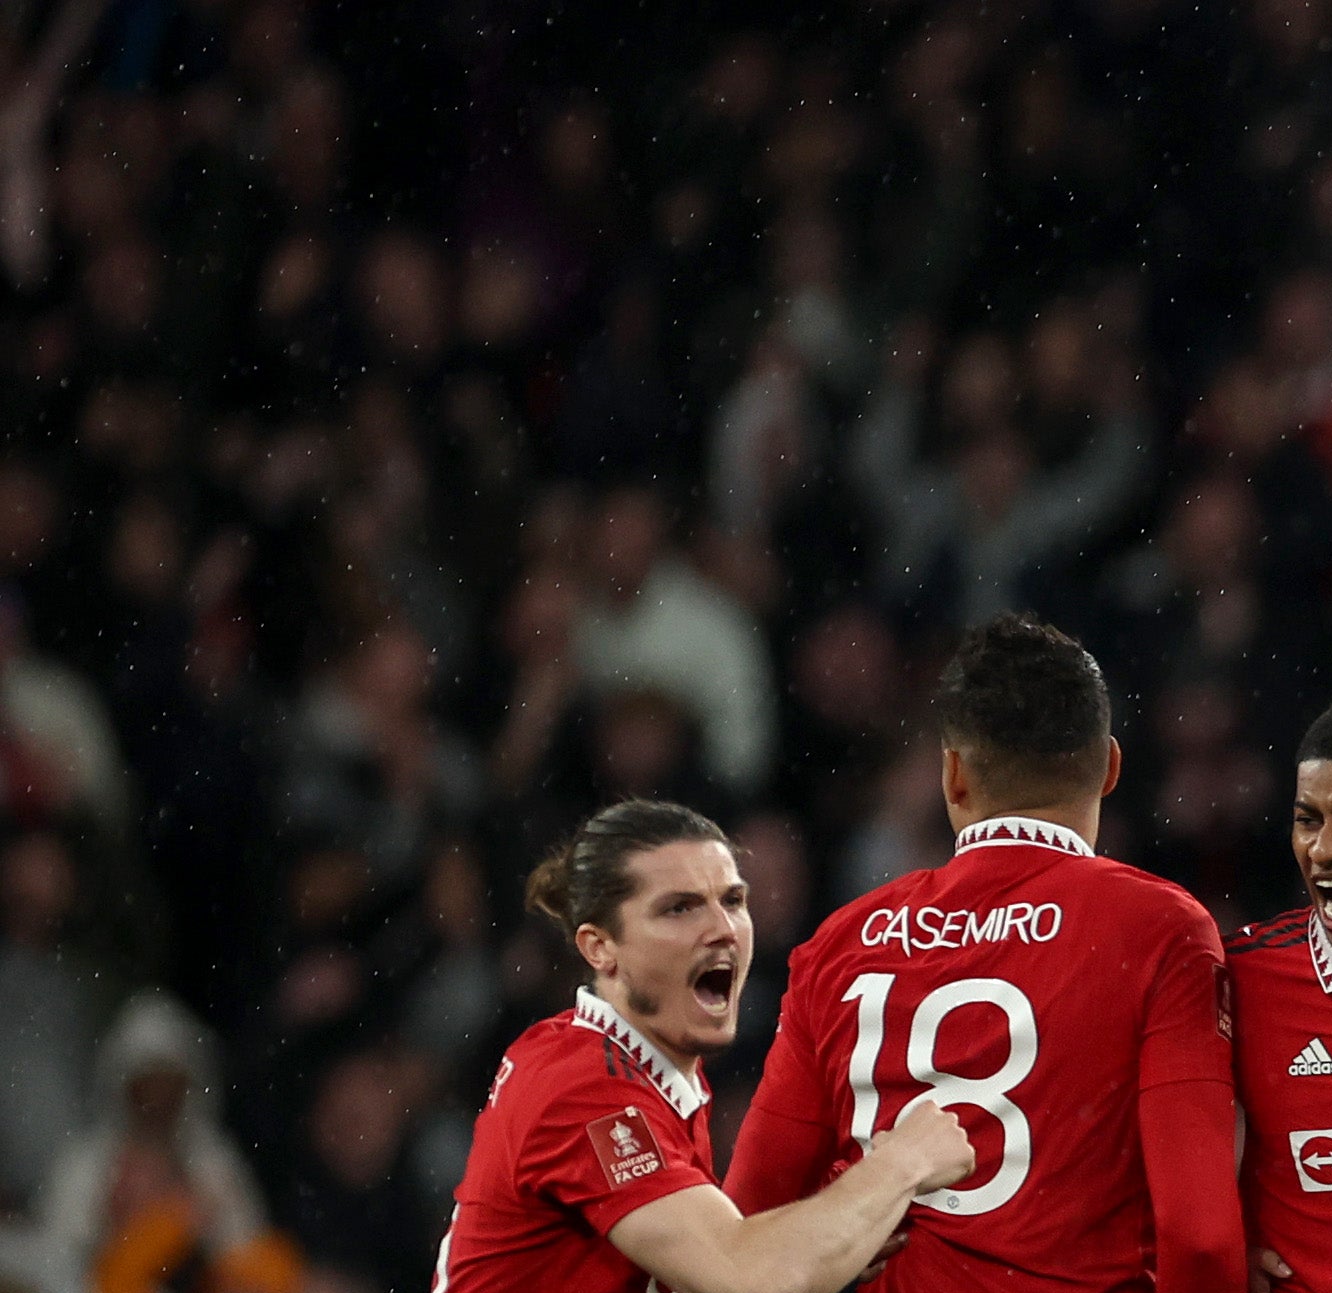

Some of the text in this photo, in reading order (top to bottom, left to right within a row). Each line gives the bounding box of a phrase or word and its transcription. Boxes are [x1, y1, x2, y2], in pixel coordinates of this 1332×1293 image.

[861, 902, 1062, 957] CASEMIRO
[841, 973, 1039, 1215] 18
[609, 1151, 656, 1174] Emirates
[614, 1159, 659, 1185] FA CUP
